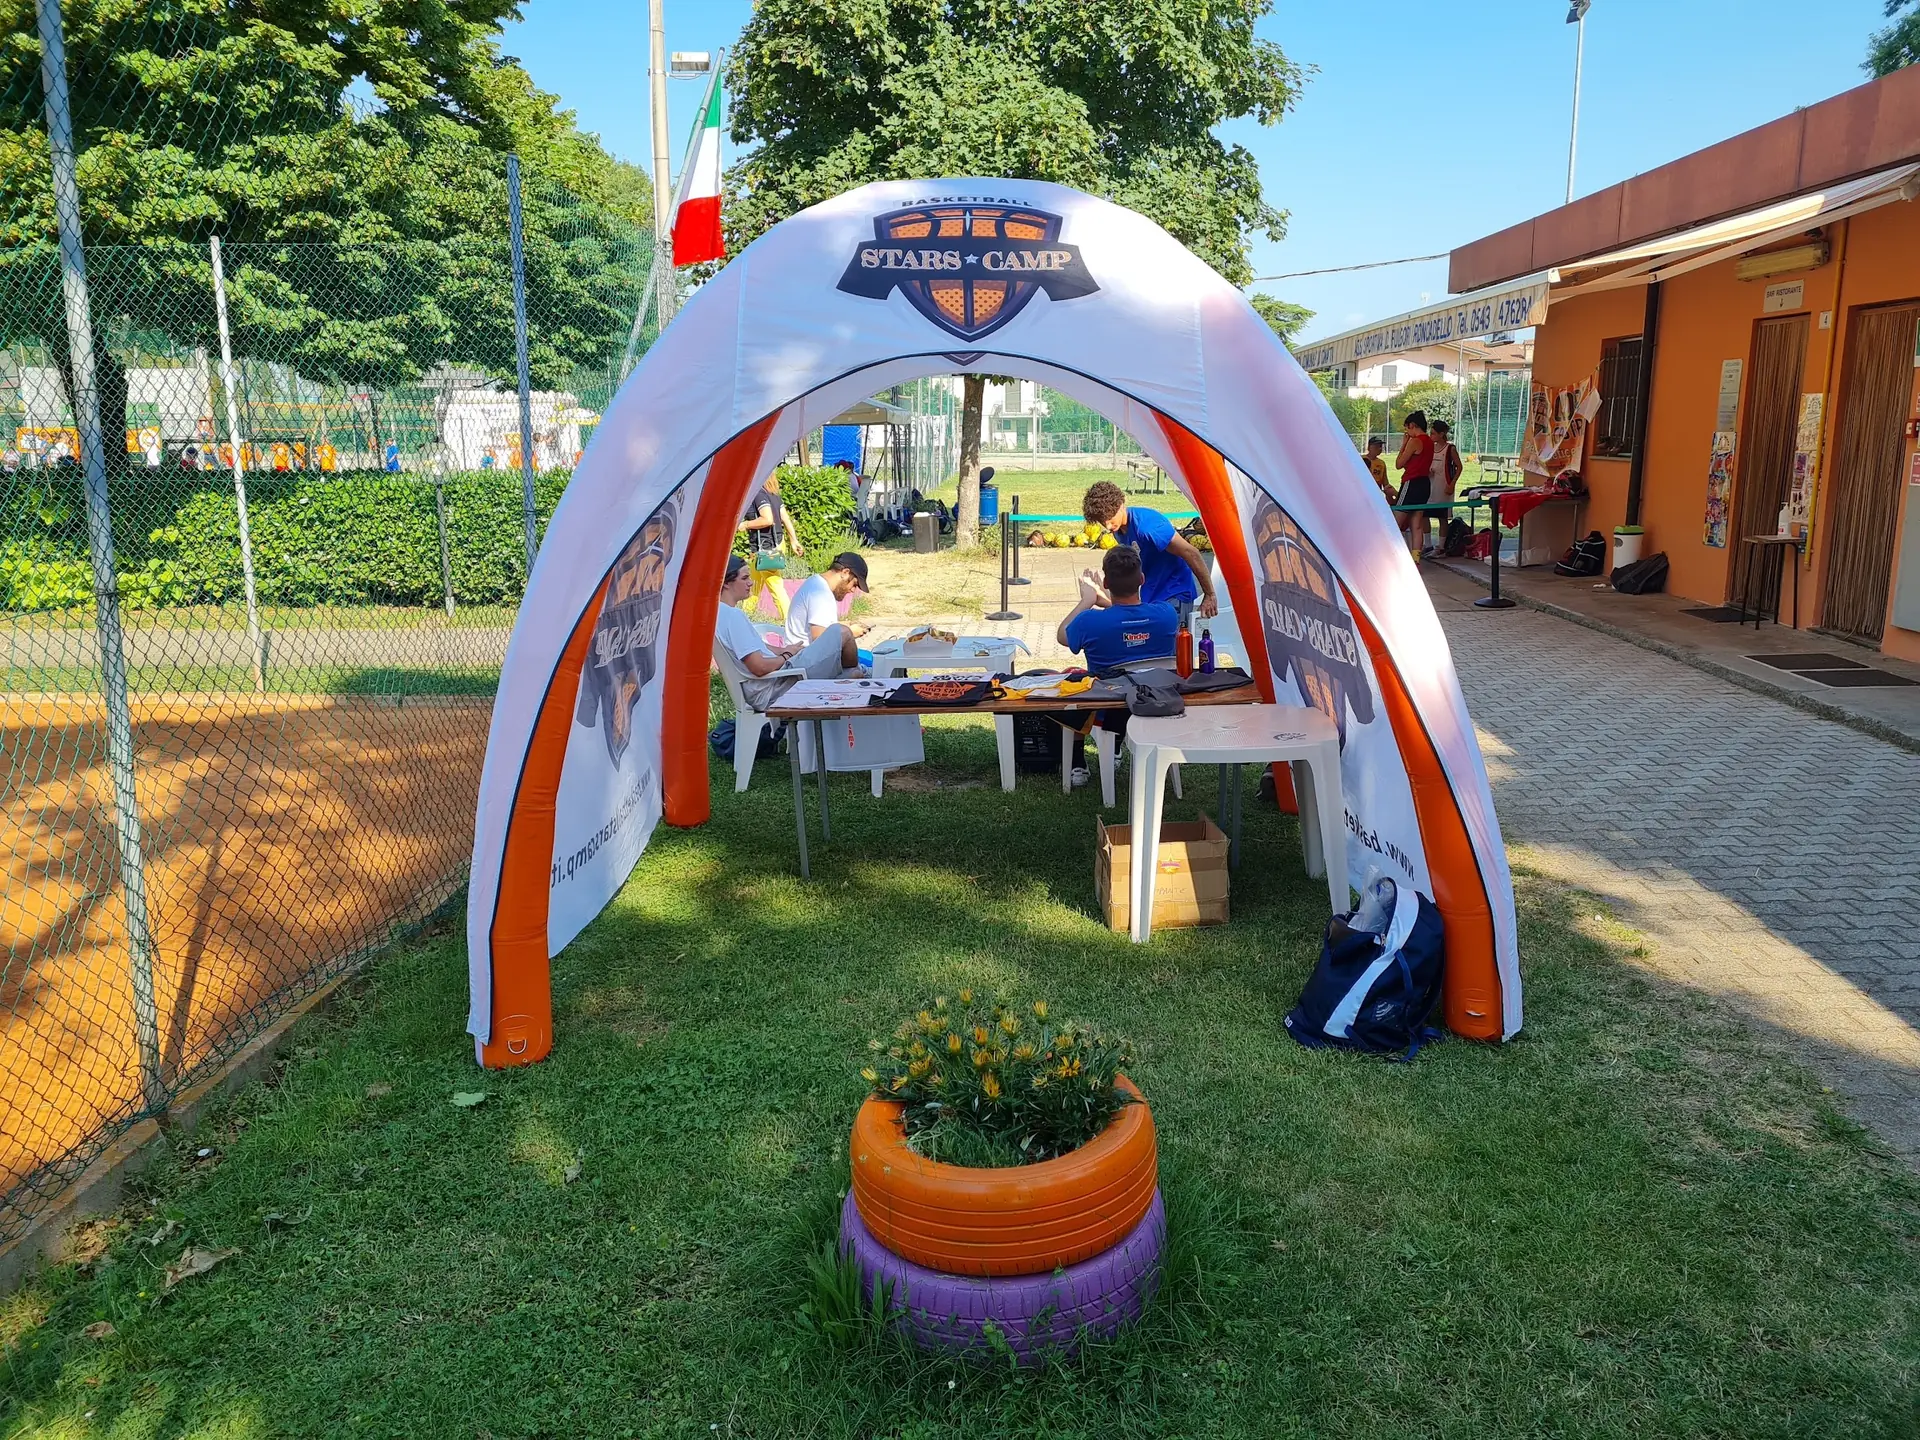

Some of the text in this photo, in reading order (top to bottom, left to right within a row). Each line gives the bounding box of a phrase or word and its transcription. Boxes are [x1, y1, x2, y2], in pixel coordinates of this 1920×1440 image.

[902, 196, 1033, 207] BASKETBALL
[860, 248, 1073, 271] STARS CAMP
[1470, 304, 1491, 333] 0543
